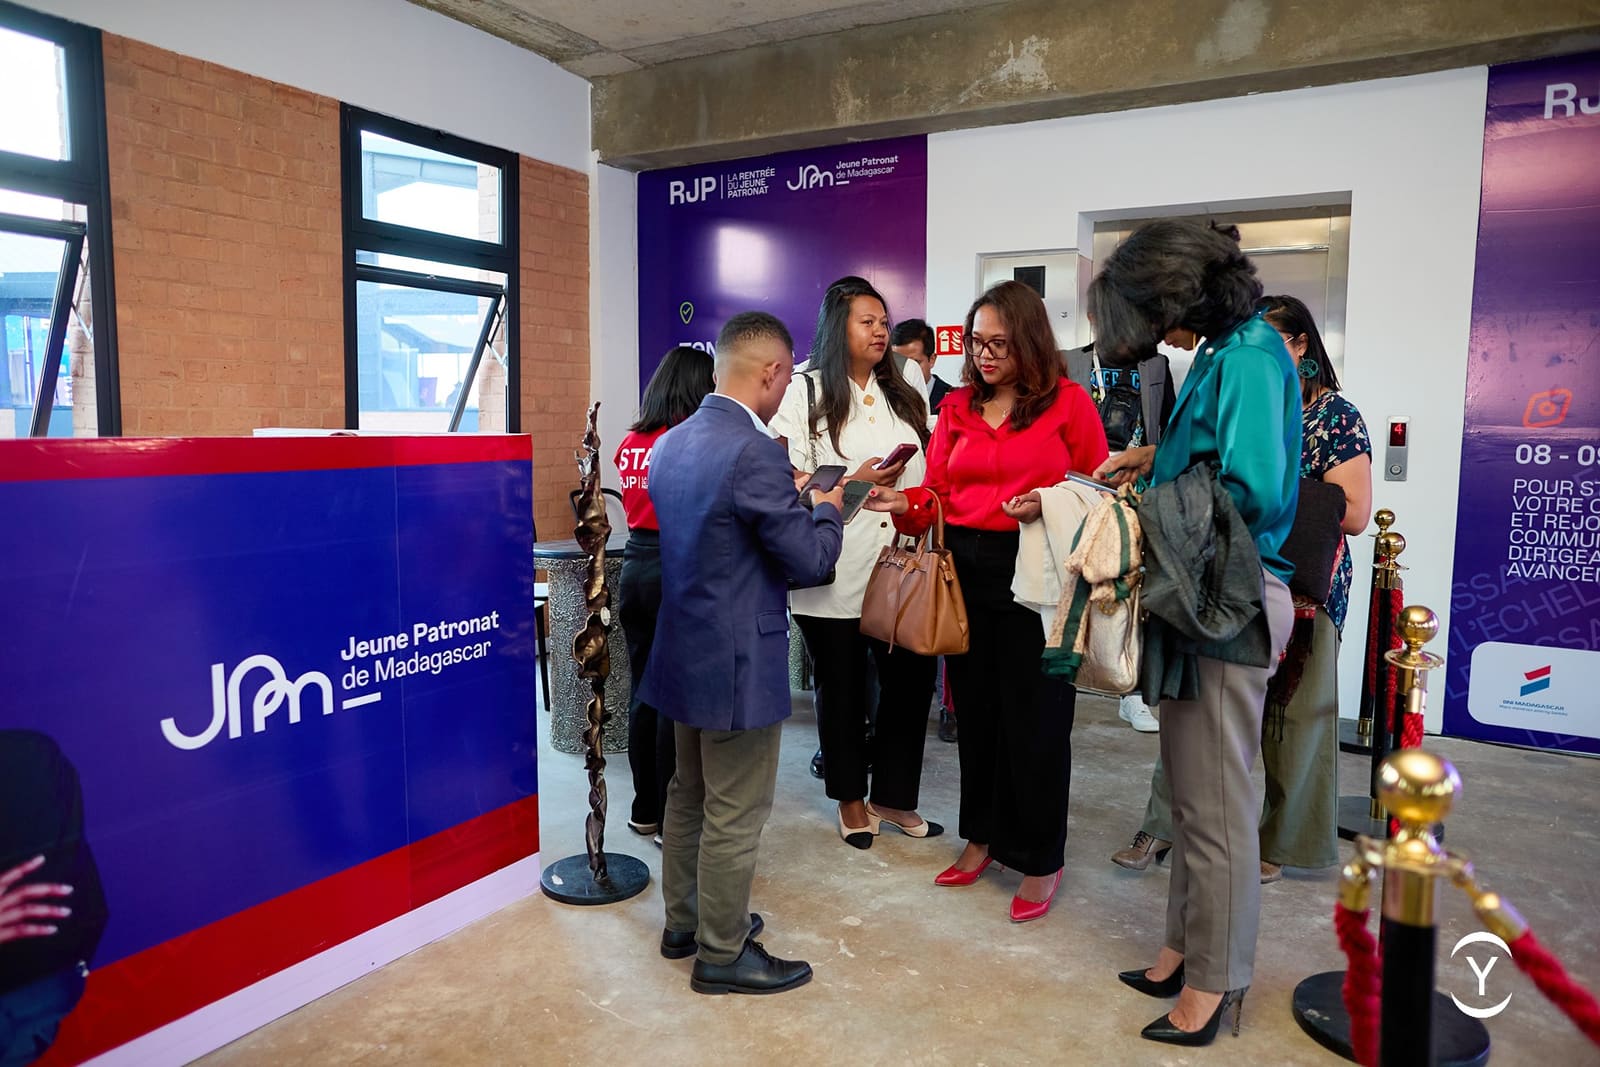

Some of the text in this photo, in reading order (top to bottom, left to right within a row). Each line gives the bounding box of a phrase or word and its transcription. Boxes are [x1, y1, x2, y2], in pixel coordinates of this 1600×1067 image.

[836, 155, 899, 170] Jeune Patronat
[727, 166, 776, 182] LA RENTRÉE
[836, 166, 895, 179] de Madagascar
[669, 176, 717, 205] RJP
[727, 178, 766, 191] DU JEUNE
[727, 185, 769, 199] PATRONAT
[1515, 444, 1552, 465] 08
[1513, 479, 1574, 496] POUR
[1512, 496, 1584, 513] VOTRE
[1511, 512, 1600, 531] ET REJO
[1509, 529, 1600, 548] COMMU
[1508, 545, 1600, 565] DIRIGEA
[1506, 562, 1600, 583] AVANCE
[341, 610, 499, 661] Jeune Patronat
[342, 639, 491, 690] de Madagascar
